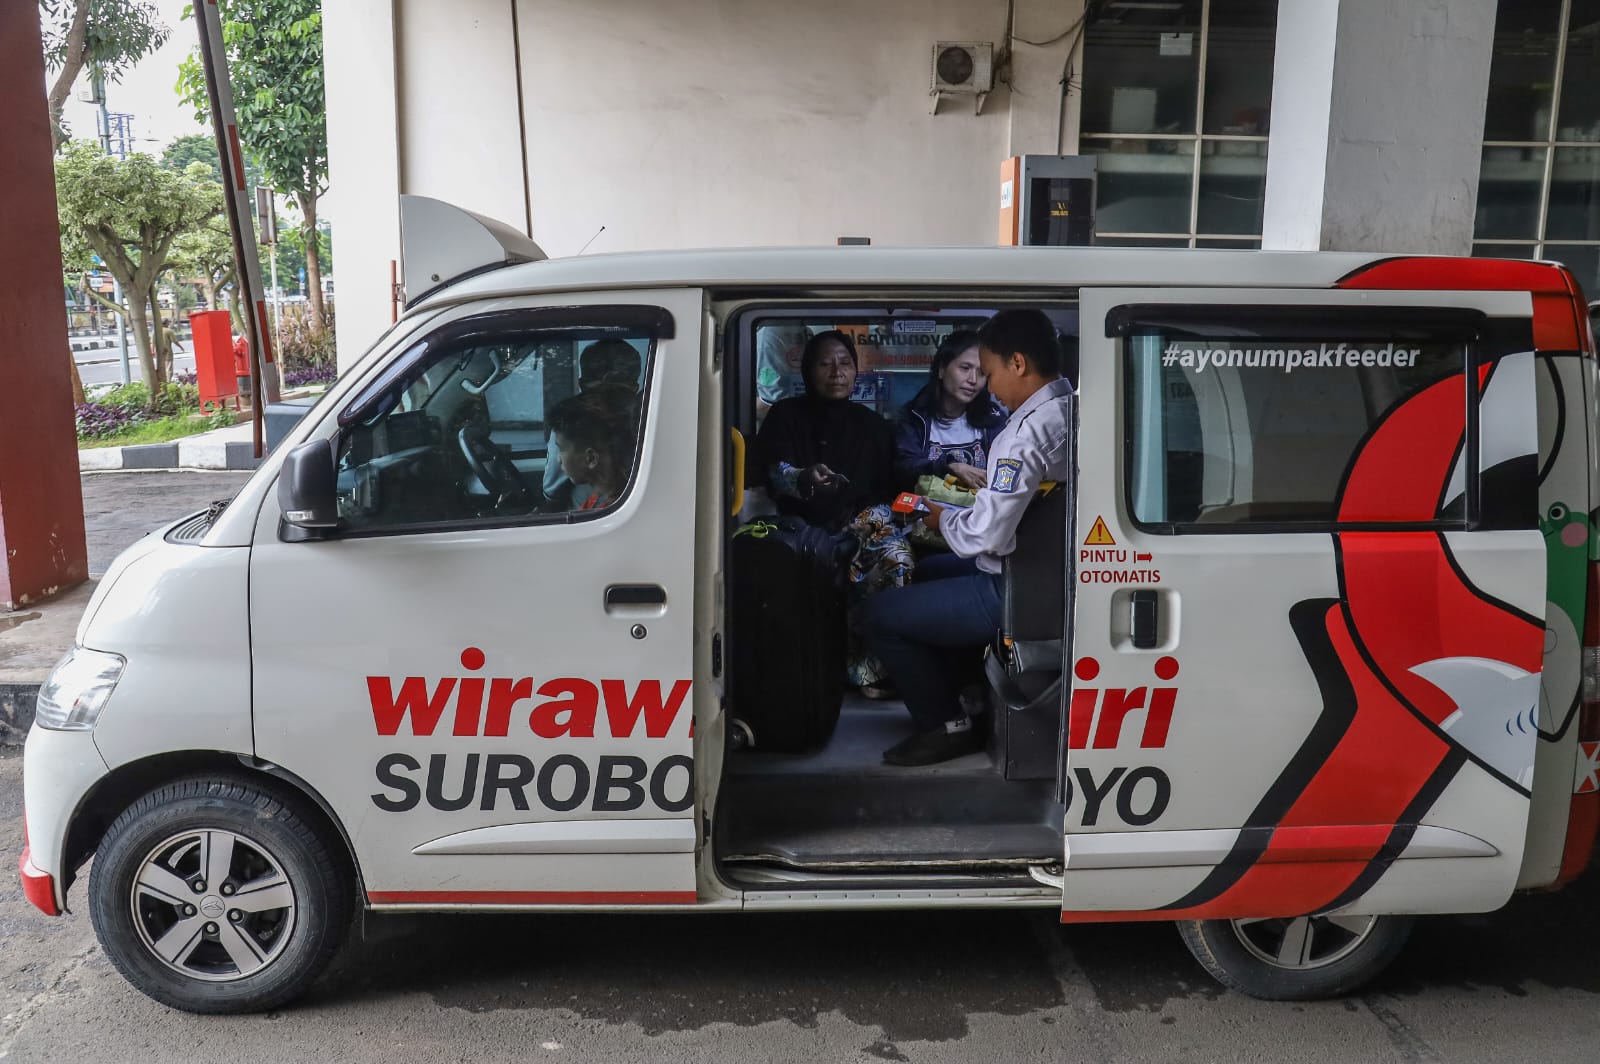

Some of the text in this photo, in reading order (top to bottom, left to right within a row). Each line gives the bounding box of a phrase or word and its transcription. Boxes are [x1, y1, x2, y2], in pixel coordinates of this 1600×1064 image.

[1162, 343, 1420, 373] #ayonumpakfeeder
[1080, 549, 1127, 563] PINTU
[1080, 570, 1161, 583] OTOMATIS
[366, 647, 694, 738] wiraw
[371, 753, 695, 812] SUROBO
[1065, 765, 1171, 826] YO
